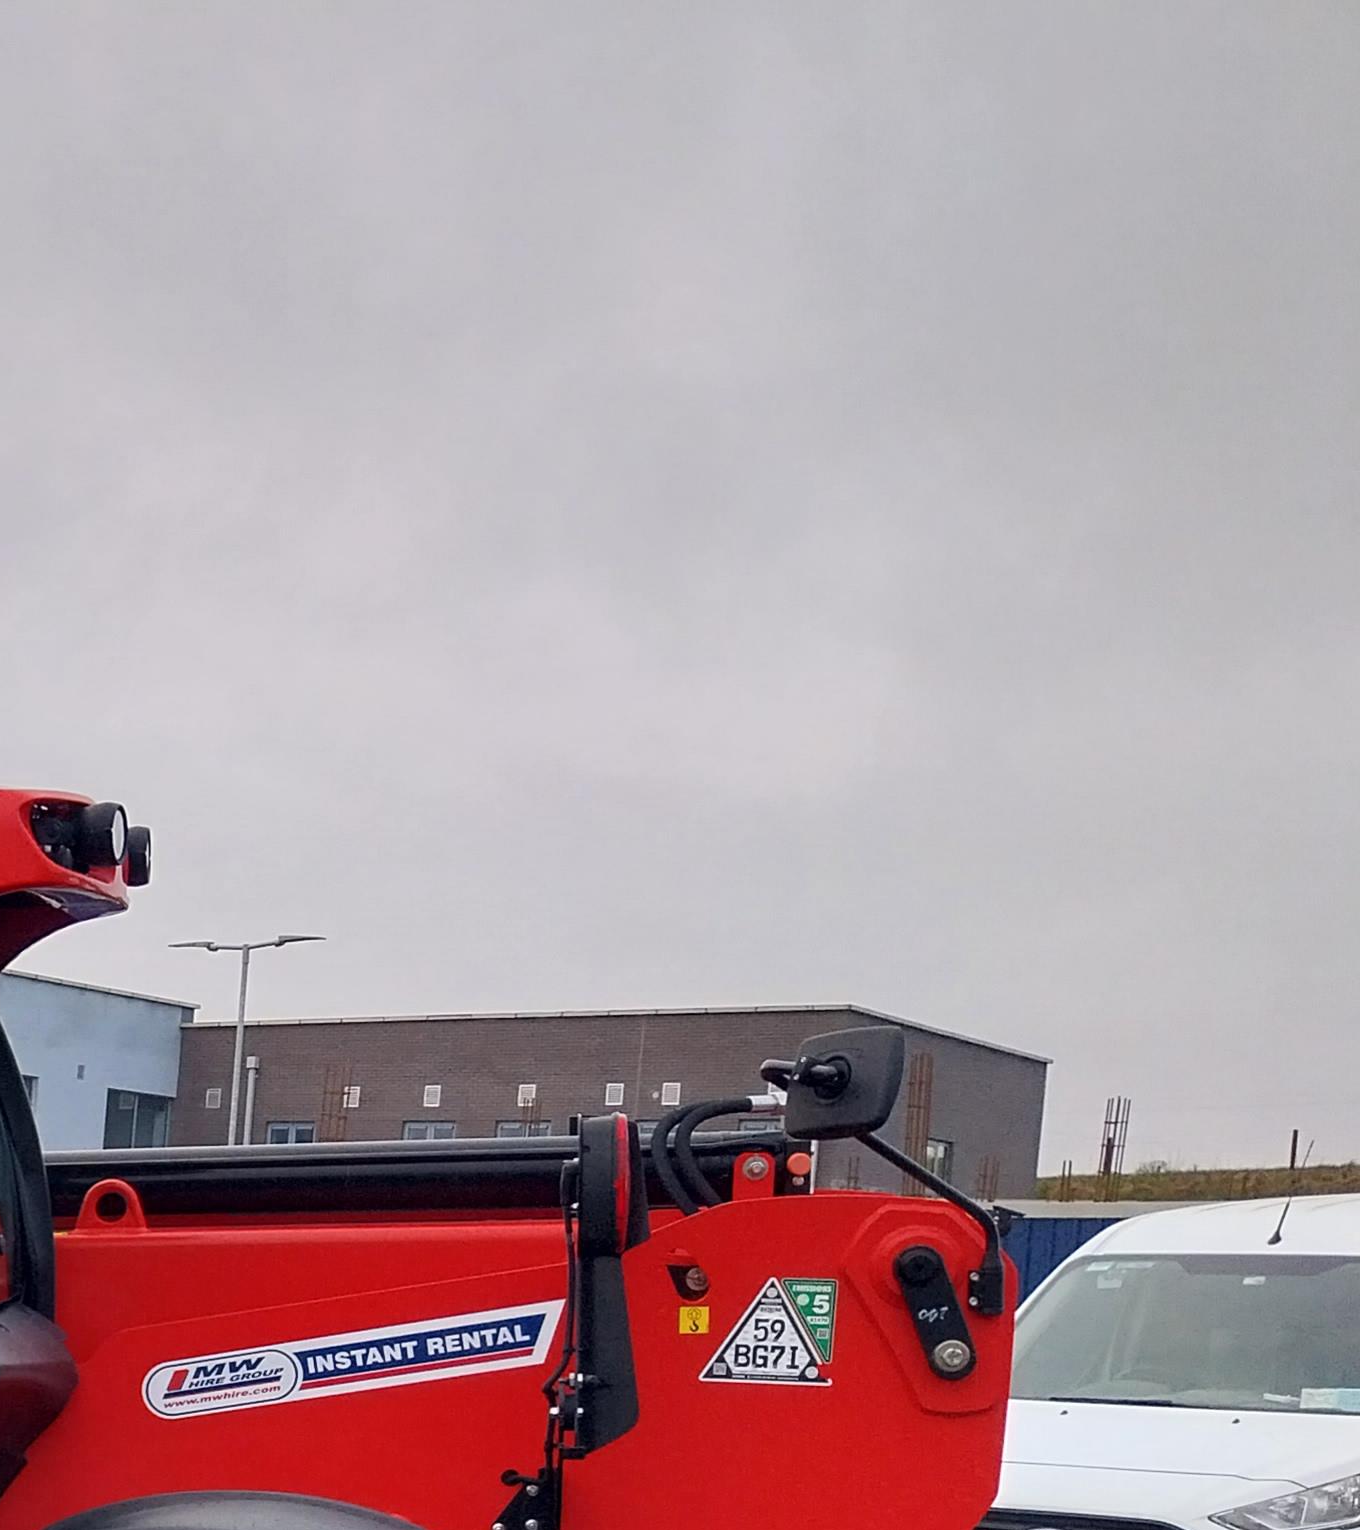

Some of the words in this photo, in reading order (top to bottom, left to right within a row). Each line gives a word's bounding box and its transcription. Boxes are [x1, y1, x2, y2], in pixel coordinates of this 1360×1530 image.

[811, 1294, 830, 1315] 5
[753, 1318, 787, 1343] 59
[306, 1340, 419, 1375] INSTANT
[426, 1323, 533, 1356] RENTAL
[187, 1374, 226, 1390] HIRE
[229, 1366, 285, 1383] GROUP
[191, 1355, 266, 1379] MW
[162, 1383, 282, 1410] www.mwhire.com
